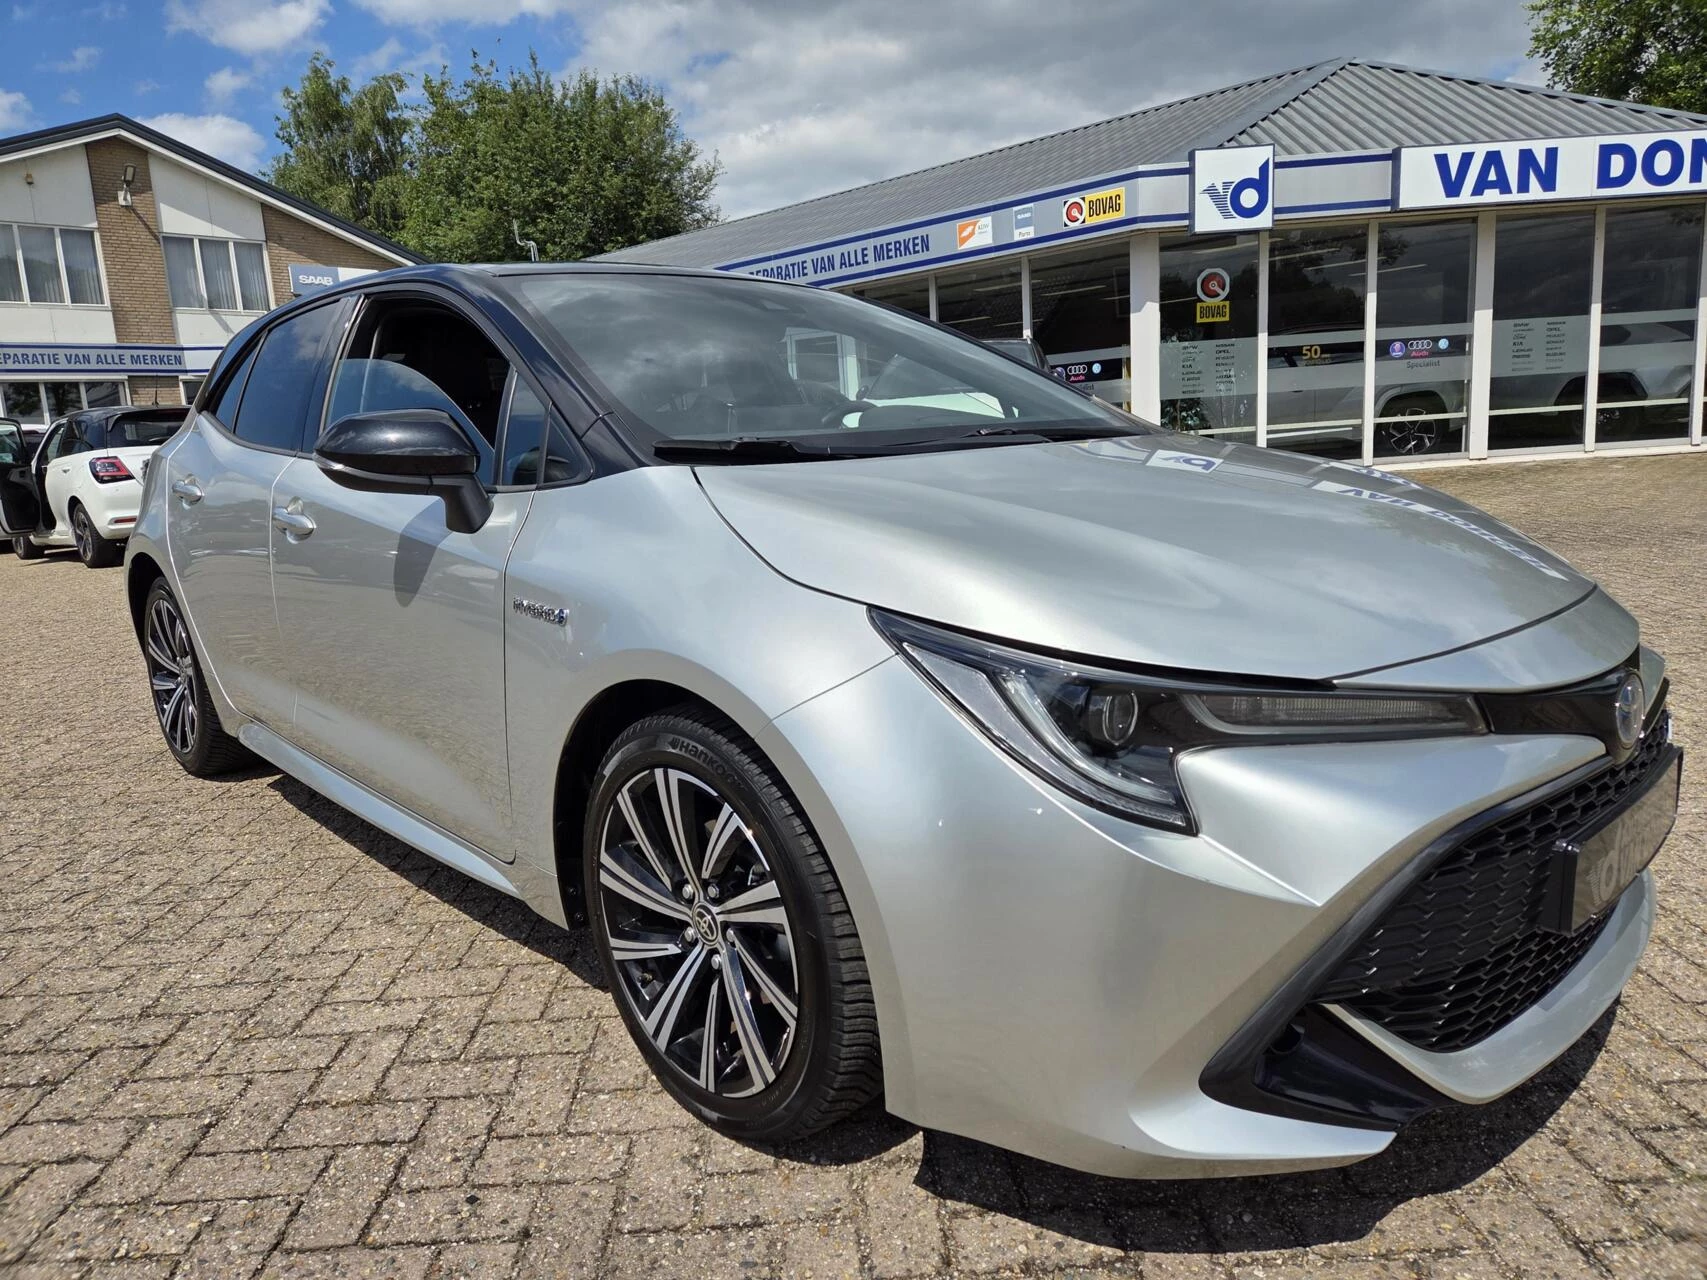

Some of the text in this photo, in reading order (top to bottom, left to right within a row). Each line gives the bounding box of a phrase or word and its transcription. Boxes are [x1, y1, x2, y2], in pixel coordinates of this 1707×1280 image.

[1434, 147, 1559, 198] VAN
[1088, 193, 1122, 218] BOVAG
[748, 234, 931, 281] PARATIE VAN ALLE MERKEN
[299, 274, 334, 286] SAAB
[1200, 304, 1228, 319] BOVAG
[64, 353, 91, 365] VAN
[96, 353, 126, 366] ALLE
[130, 354, 182, 367] MERKEN
[1302, 345, 1321, 360] 50
[1406, 360, 1441, 369] Specialist
